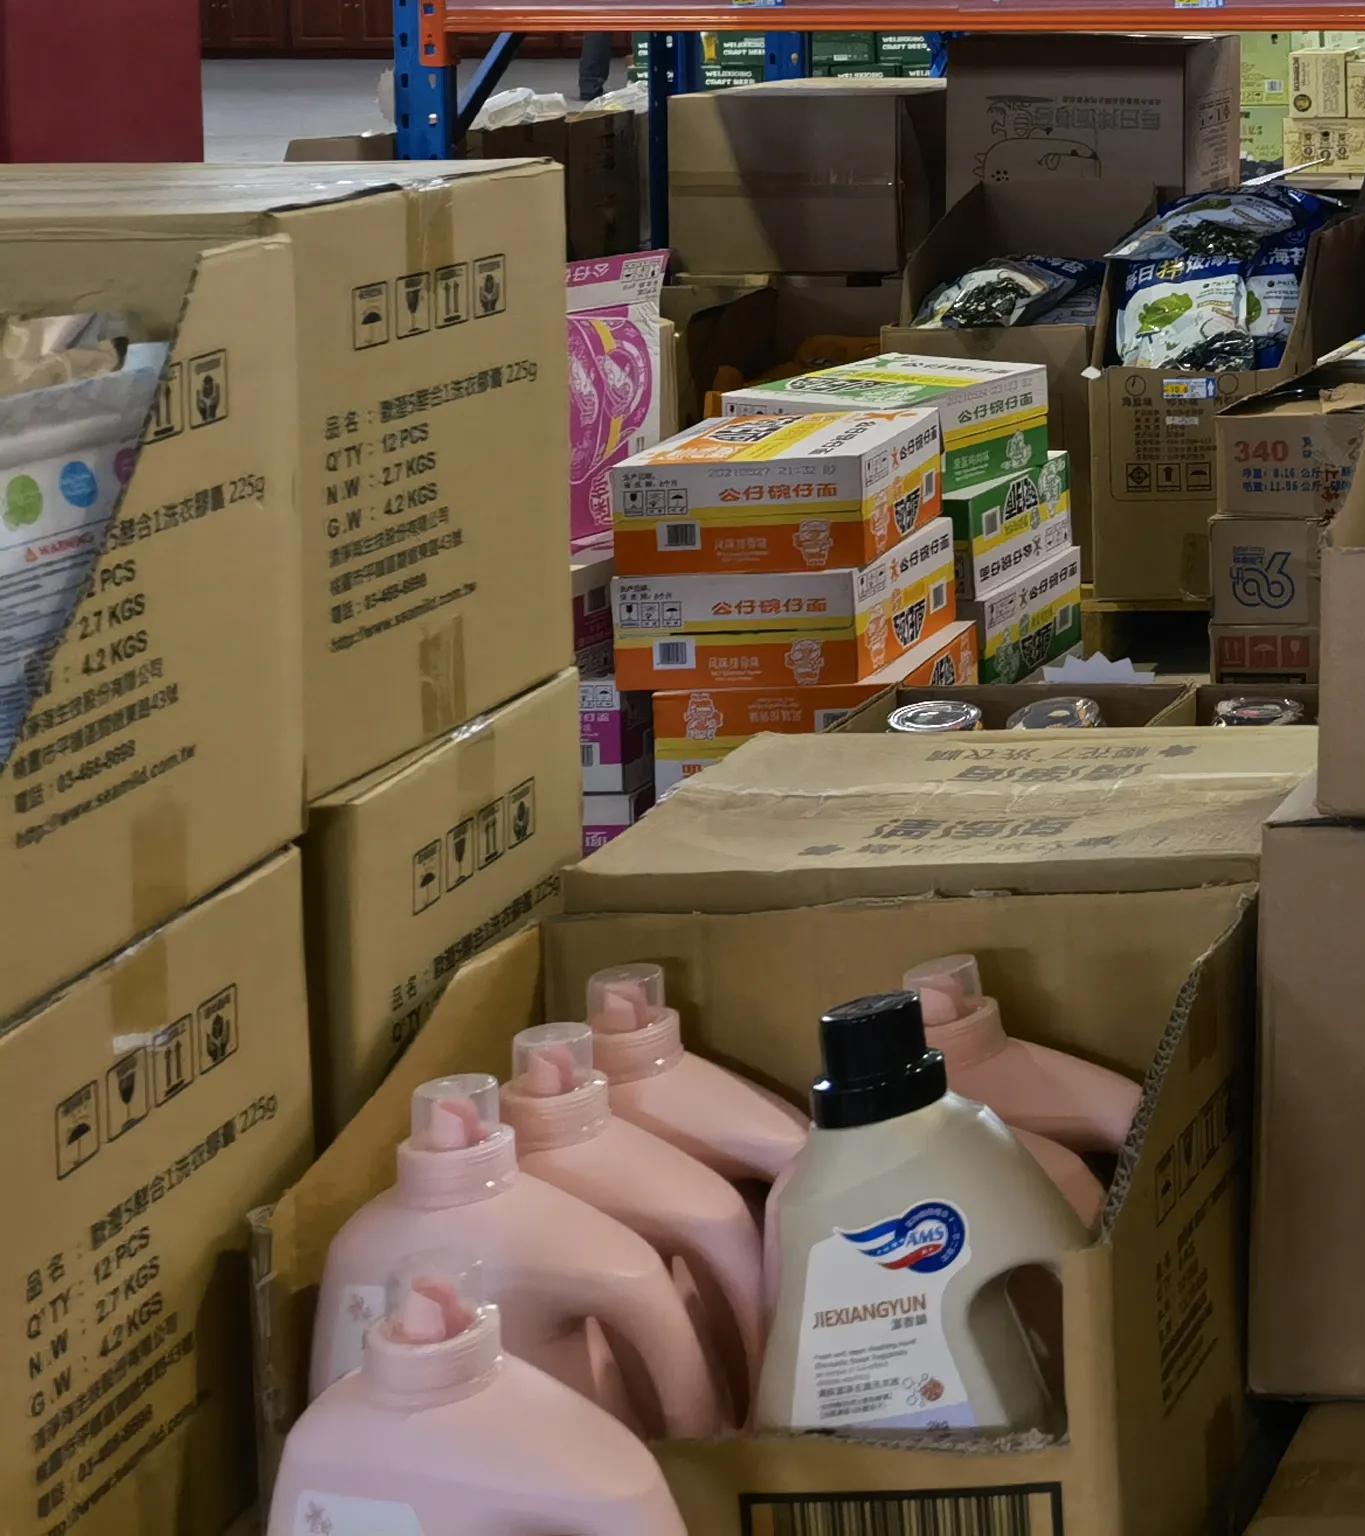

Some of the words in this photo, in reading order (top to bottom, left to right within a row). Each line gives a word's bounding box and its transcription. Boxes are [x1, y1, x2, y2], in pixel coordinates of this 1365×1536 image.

[505, 360, 539, 383] 225g
[957, 392, 1034, 424] 公仔碗仔面
[399, 423, 430, 448] PCS
[406, 452, 437, 478] KGS
[1234, 440, 1288, 462] 340
[228, 475, 266, 504] 225g
[407, 482, 438, 507] KGS
[719, 483, 839, 503] 公仔碗仔面
[100, 560, 137, 592] PCS
[108, 593, 146, 629] KGS
[711, 598, 828, 616] 公仔碗仔面
[111, 630, 149, 665] KGS
[114, 1225, 152, 1264] PCS
[905, 1225, 945, 1249] AMS
[122, 1254, 161, 1301] KGS
[126, 1290, 165, 1336] KGS
[812, 1293, 928, 1331] JIEXIANGYUN
